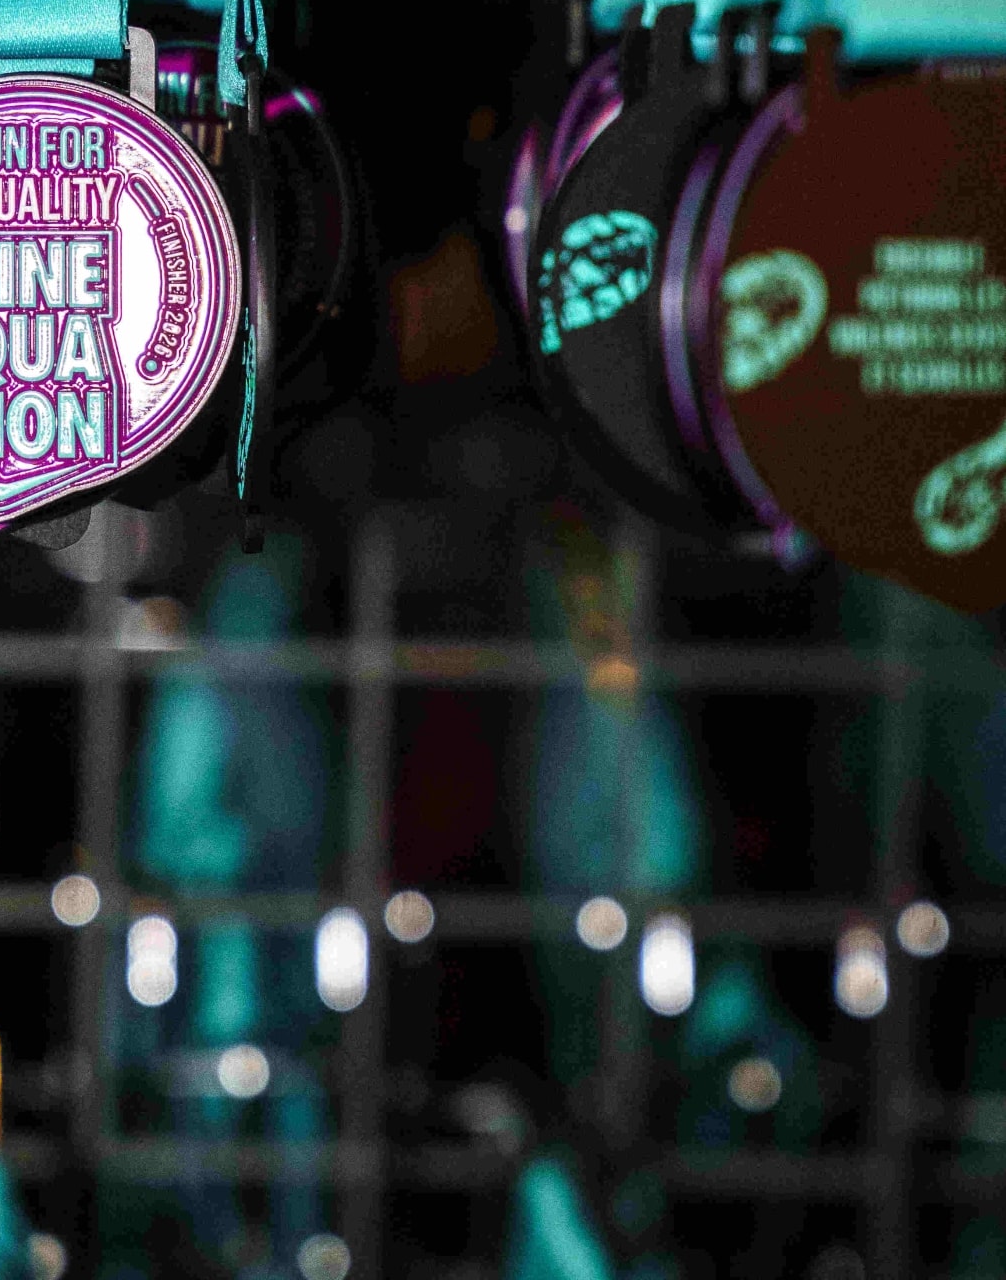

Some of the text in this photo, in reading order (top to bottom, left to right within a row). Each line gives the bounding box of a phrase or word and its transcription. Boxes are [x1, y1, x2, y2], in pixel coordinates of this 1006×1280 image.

[39, 125, 106, 170] FOR
[153, 222, 188, 359] FINISHER 2026
